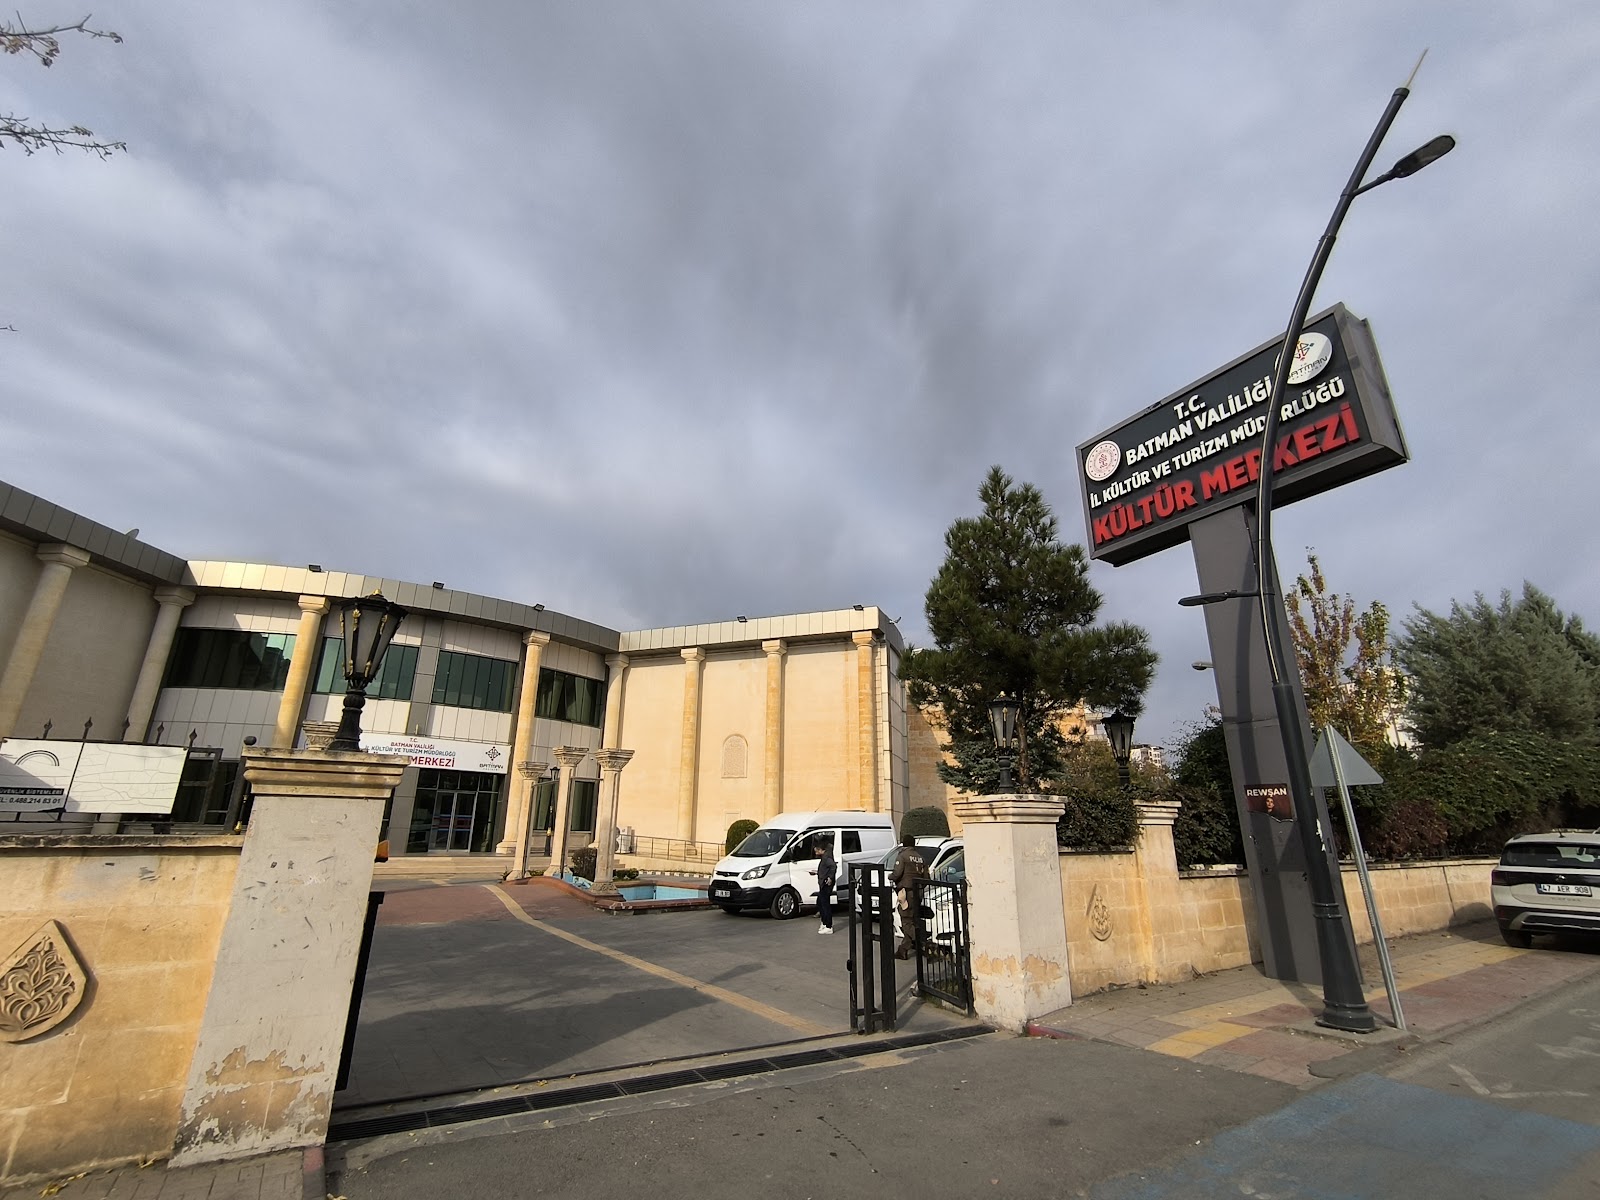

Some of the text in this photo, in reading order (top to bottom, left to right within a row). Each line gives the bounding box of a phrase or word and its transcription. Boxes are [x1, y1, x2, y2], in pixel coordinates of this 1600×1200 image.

[1288, 355, 1328, 379] ATMAN
[1174, 395, 1206, 420] T.C.
[1126, 420, 1193, 466] BATMAN
[1194, 375, 1272, 431] VALİLİĞİ
[1090, 493, 1102, 509] İL
[1103, 470, 1151, 503] KÜLTÜR
[1152, 461, 1171, 479] VE
[1172, 434, 1229, 470] TURİZM
[1230, 376, 1345, 445] MÜDRLÜĞÜ
[1093, 480, 1198, 544] KÜLTÜR
[410, 755, 455, 768] MERKEZİ
[1246, 787, 1288, 798] REWŞAN
[1557, 885, 1571, 893] AER
